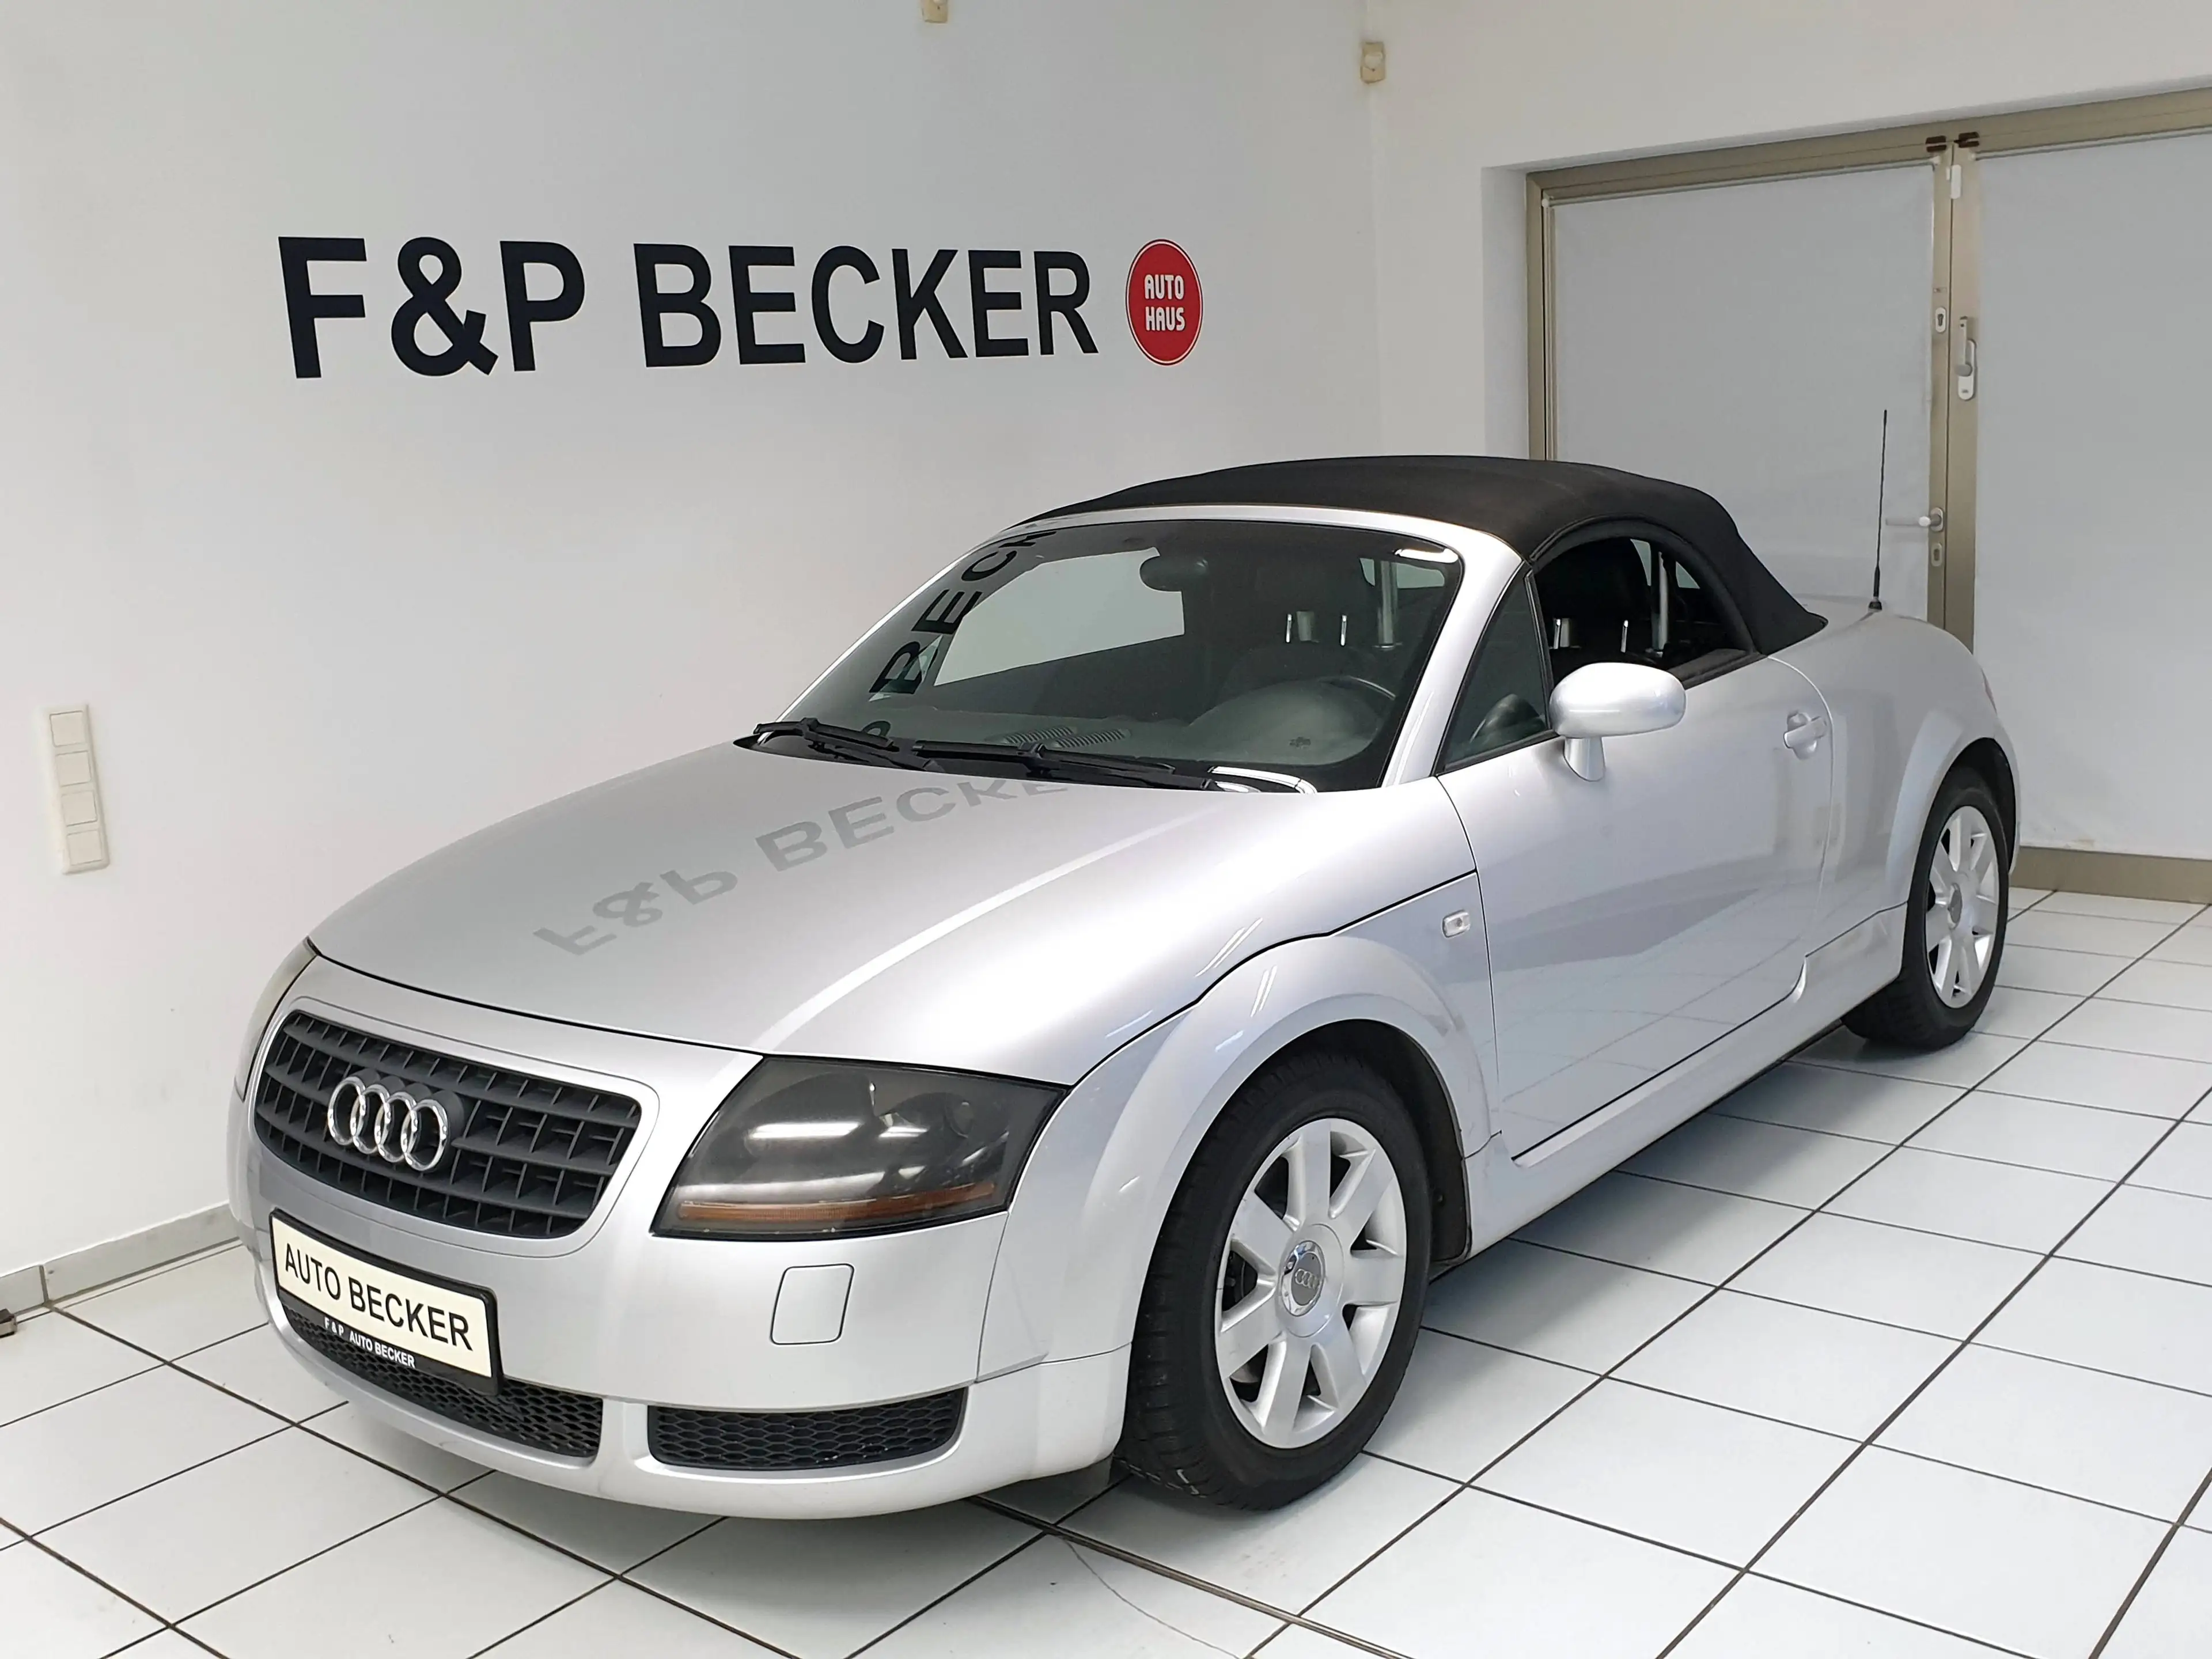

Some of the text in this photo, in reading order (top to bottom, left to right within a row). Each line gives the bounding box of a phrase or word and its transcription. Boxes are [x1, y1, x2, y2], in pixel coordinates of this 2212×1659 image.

[1144, 274, 1184, 300] AUTO
[278, 236, 1099, 378] F&P BECKER
[1145, 306, 1185, 331] HAUS
[285, 1243, 473, 1351] AUTO BECKER
[349, 1331, 373, 1351] AUTO
[374, 1342, 415, 1368] BECKER
